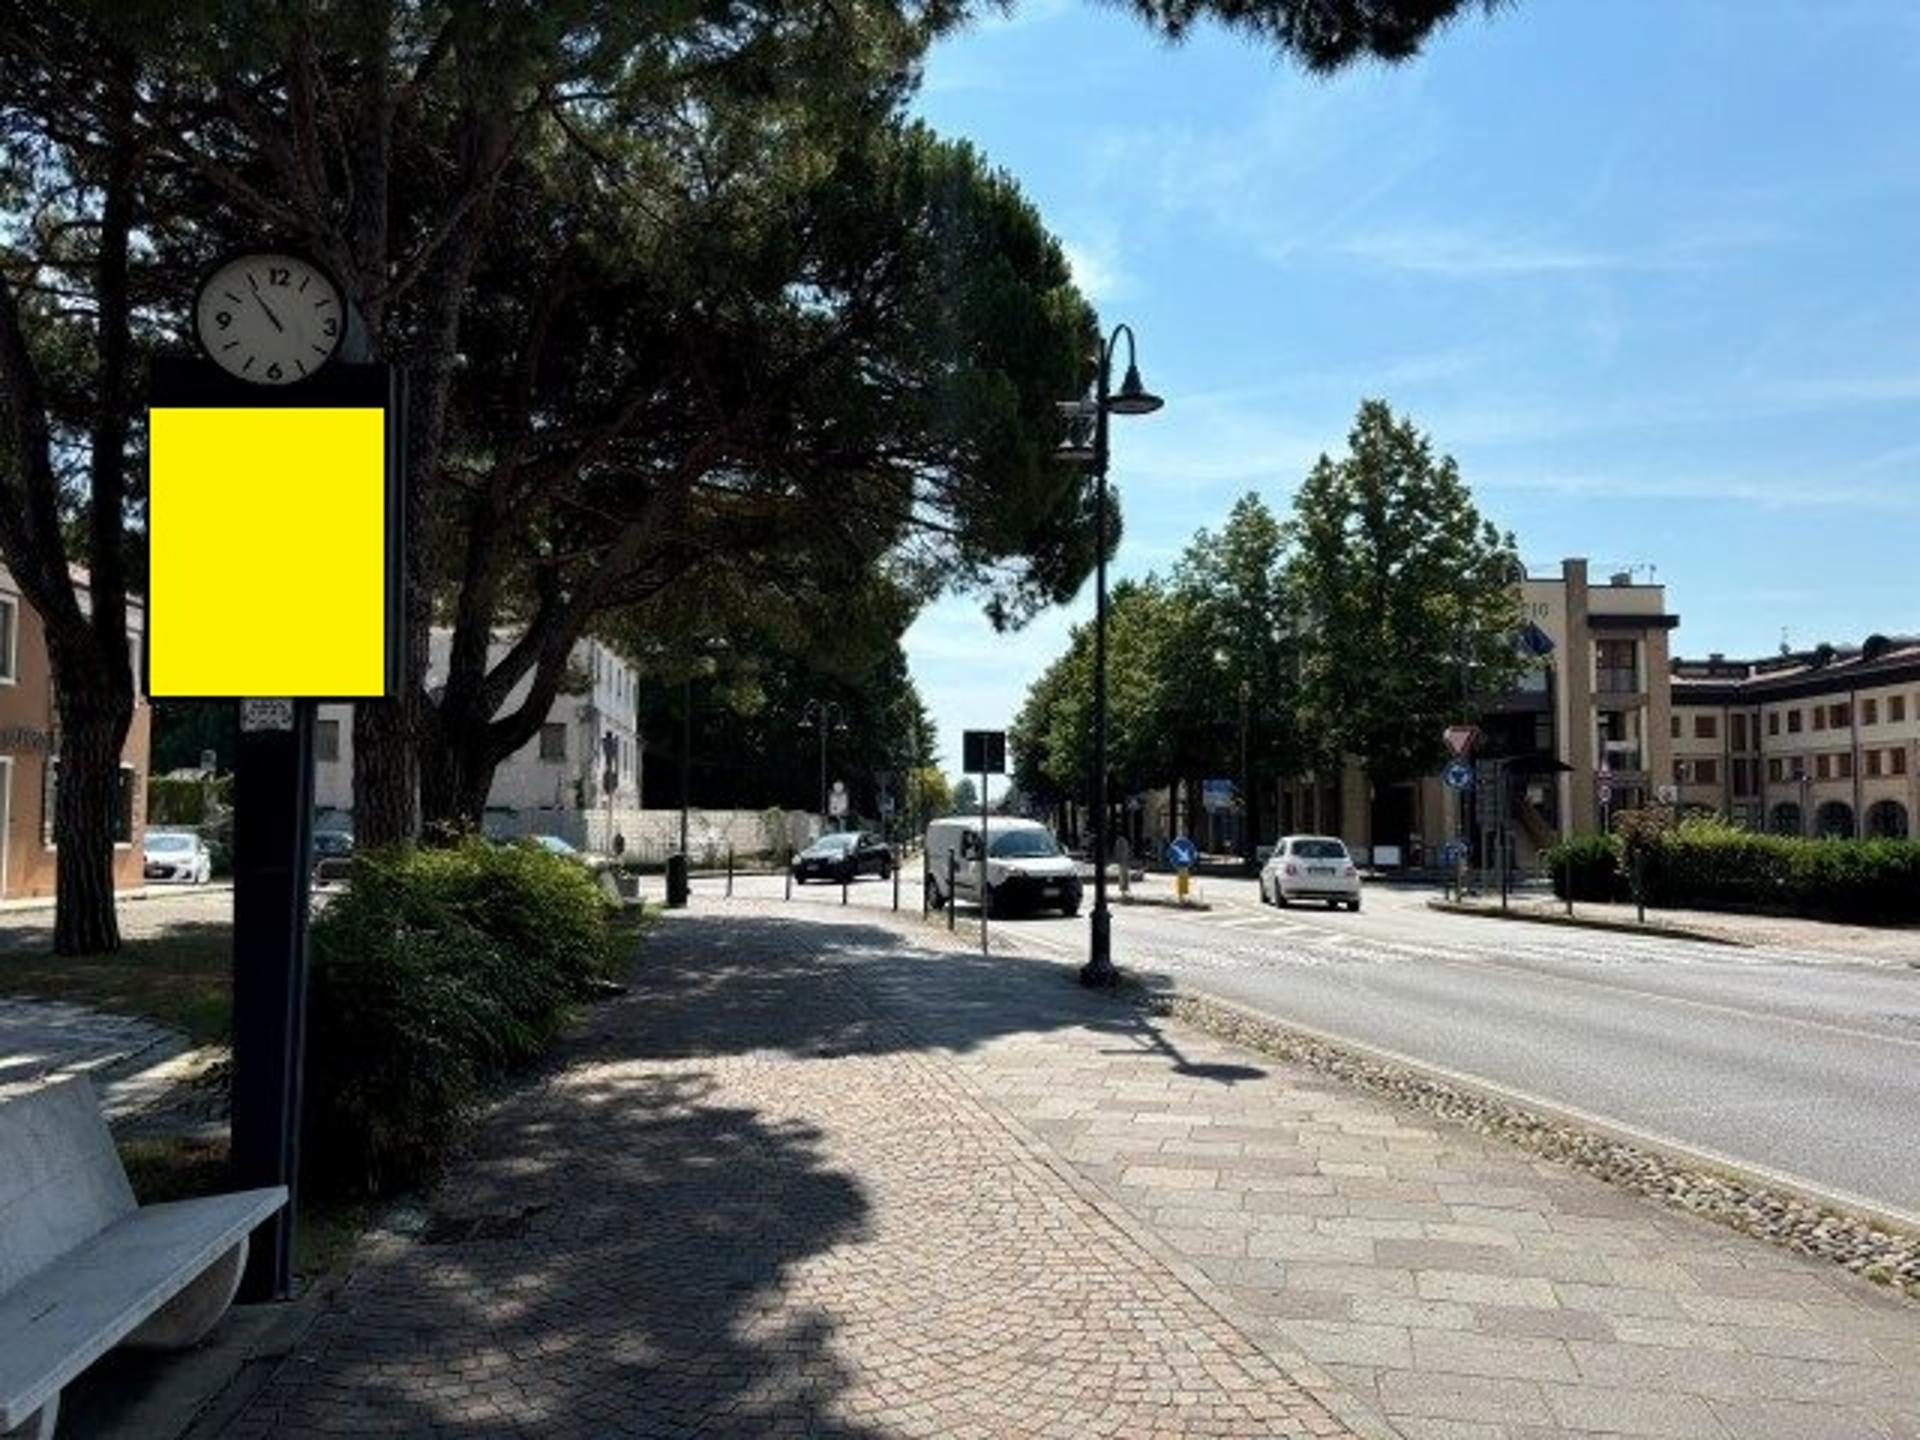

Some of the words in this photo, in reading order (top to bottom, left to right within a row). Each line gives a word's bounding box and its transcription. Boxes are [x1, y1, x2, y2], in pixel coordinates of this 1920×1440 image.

[269, 268, 290, 286] 12
[216, 311, 232, 331] 9
[323, 317, 337, 337] 3
[266, 362, 283, 380] 6
